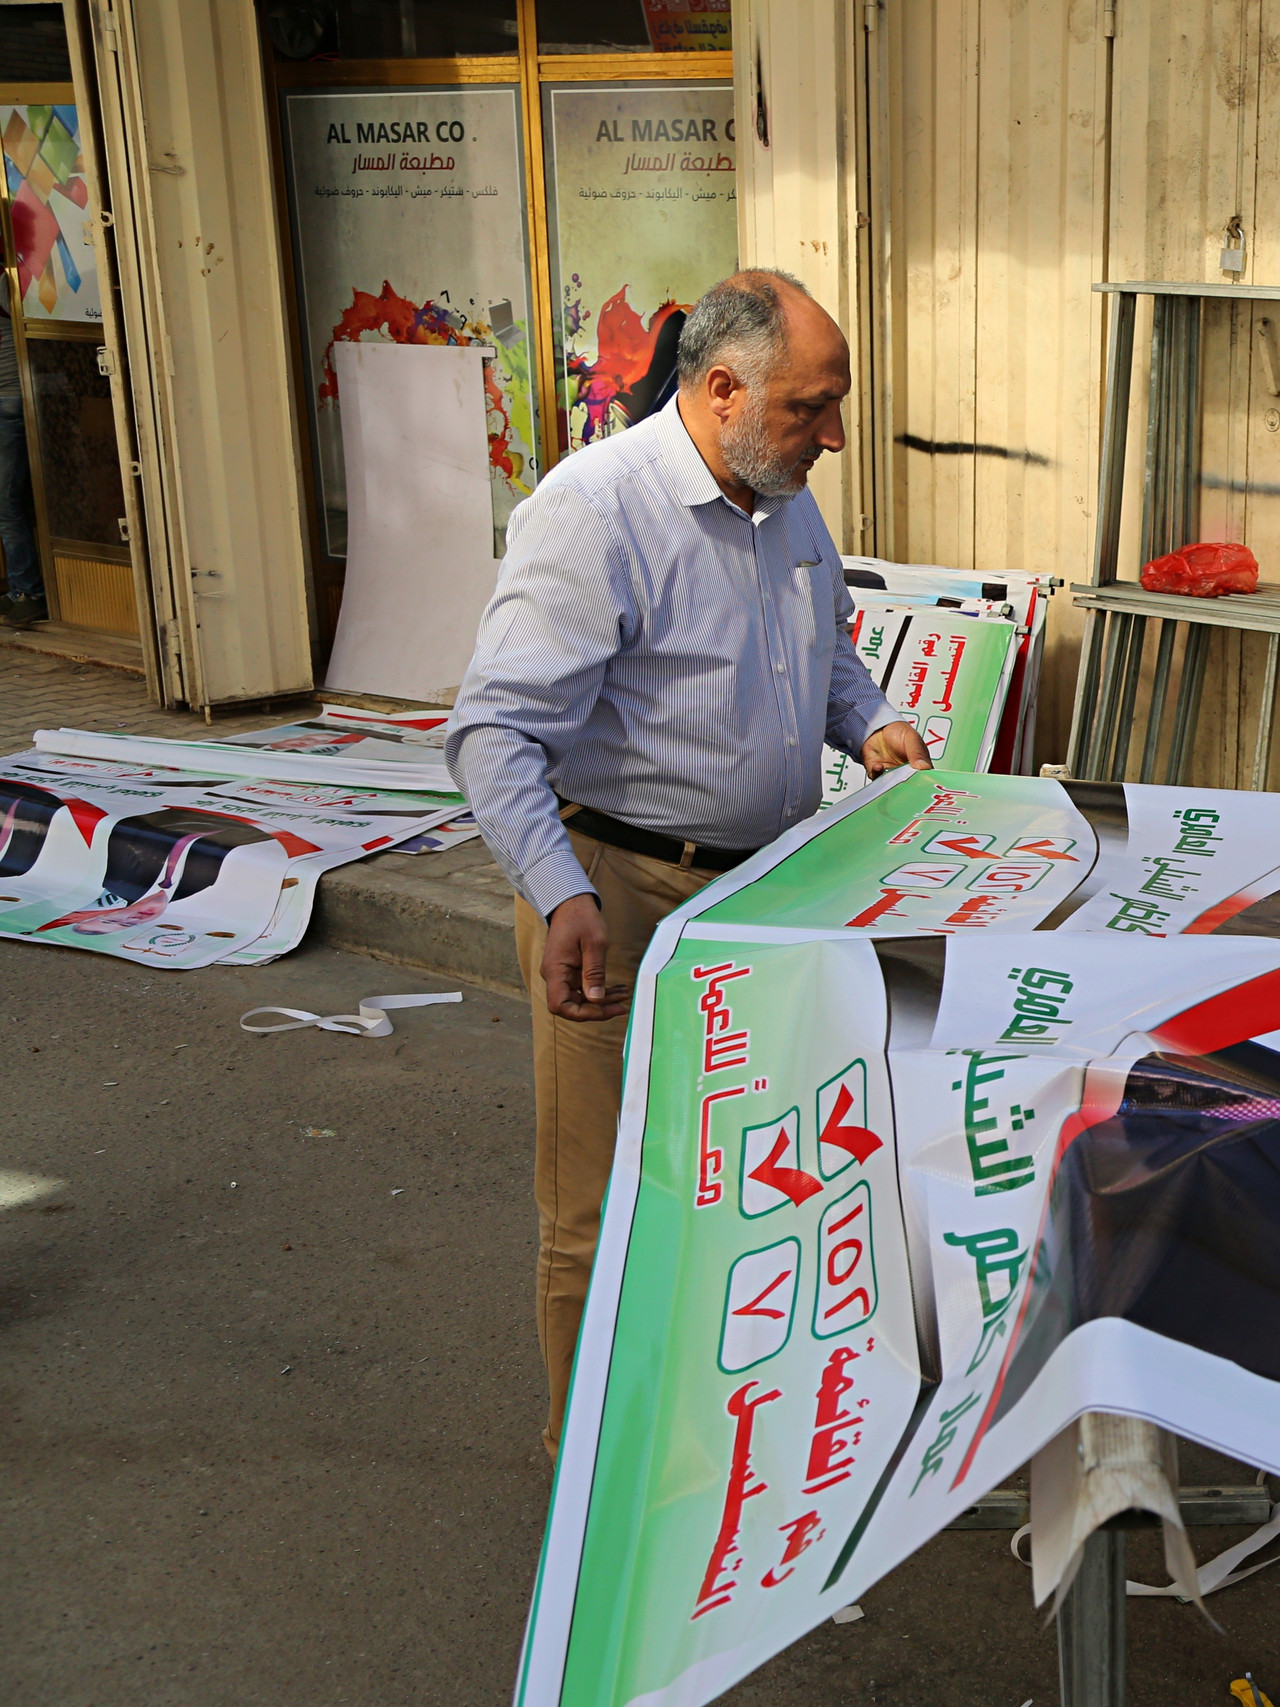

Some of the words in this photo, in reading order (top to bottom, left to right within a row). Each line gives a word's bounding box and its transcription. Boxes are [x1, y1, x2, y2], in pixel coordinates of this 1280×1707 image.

[327, 123, 351, 144] AL
[357, 121, 430, 144] MASAR
[596, 120, 624, 142] AL
[632, 119, 718, 142] MASAR
[725, 118, 736, 142] C
[352, 153, 396, 174] المسار
[399, 152, 455, 175] مطبعة
[623, 153, 676, 175] المسار
[680, 152, 736, 177] طبعة
[341, 185, 364, 199] حروف
[610, 190, 636, 201] حروف
[862, 626, 885, 660] عمار
[918, 633, 941, 657] رقم
[900, 661, 929, 709] القائمة
[932, 635, 967, 713] التسلسل
[1105, 892, 1172, 935] كاظم
[1141, 856, 1202, 901] الشبلي
[1173, 807, 1225, 857] العامري
[940, 895, 1018, 927] القائمة
[999, 967, 1074, 1044] العامري
[945, 1049, 1035, 1197] الشبلي
[825, 1204, 871, 1320] ١٥٢
[733, 1270, 792, 1320] ٧
[943, 1227, 1030, 1376] كاظم
[803, 1338, 875, 1495] القائمة
[909, 1391, 980, 1499] عمار
[691, 1381, 783, 1621] التسلسل
[761, 1510, 826, 1589] رقم
